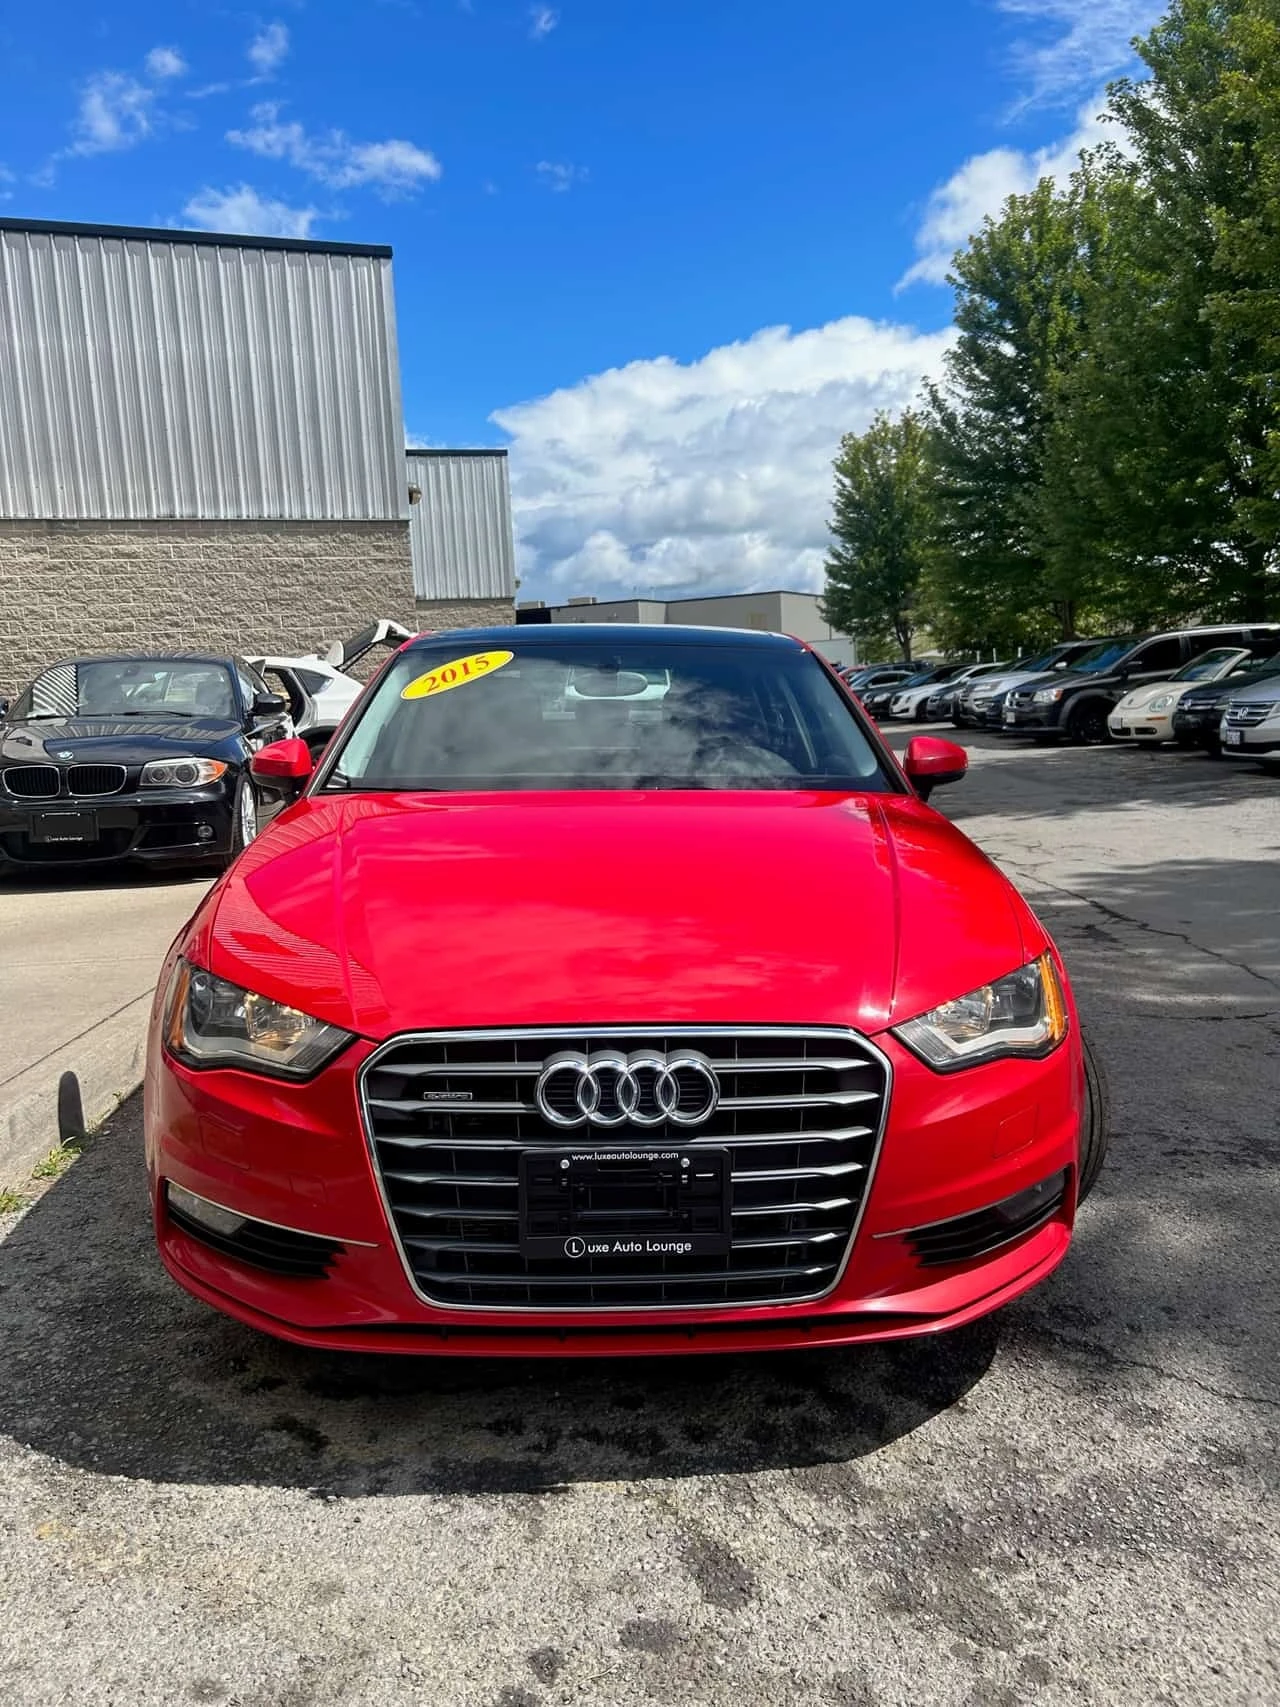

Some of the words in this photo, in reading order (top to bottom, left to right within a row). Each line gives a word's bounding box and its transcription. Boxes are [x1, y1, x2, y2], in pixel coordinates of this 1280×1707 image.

[423, 655, 490, 693] 2015
[571, 1151, 679, 1161] www.luxeautolounge.com
[612, 1241, 642, 1253] Auto
[646, 1240, 692, 1254] Lounge
